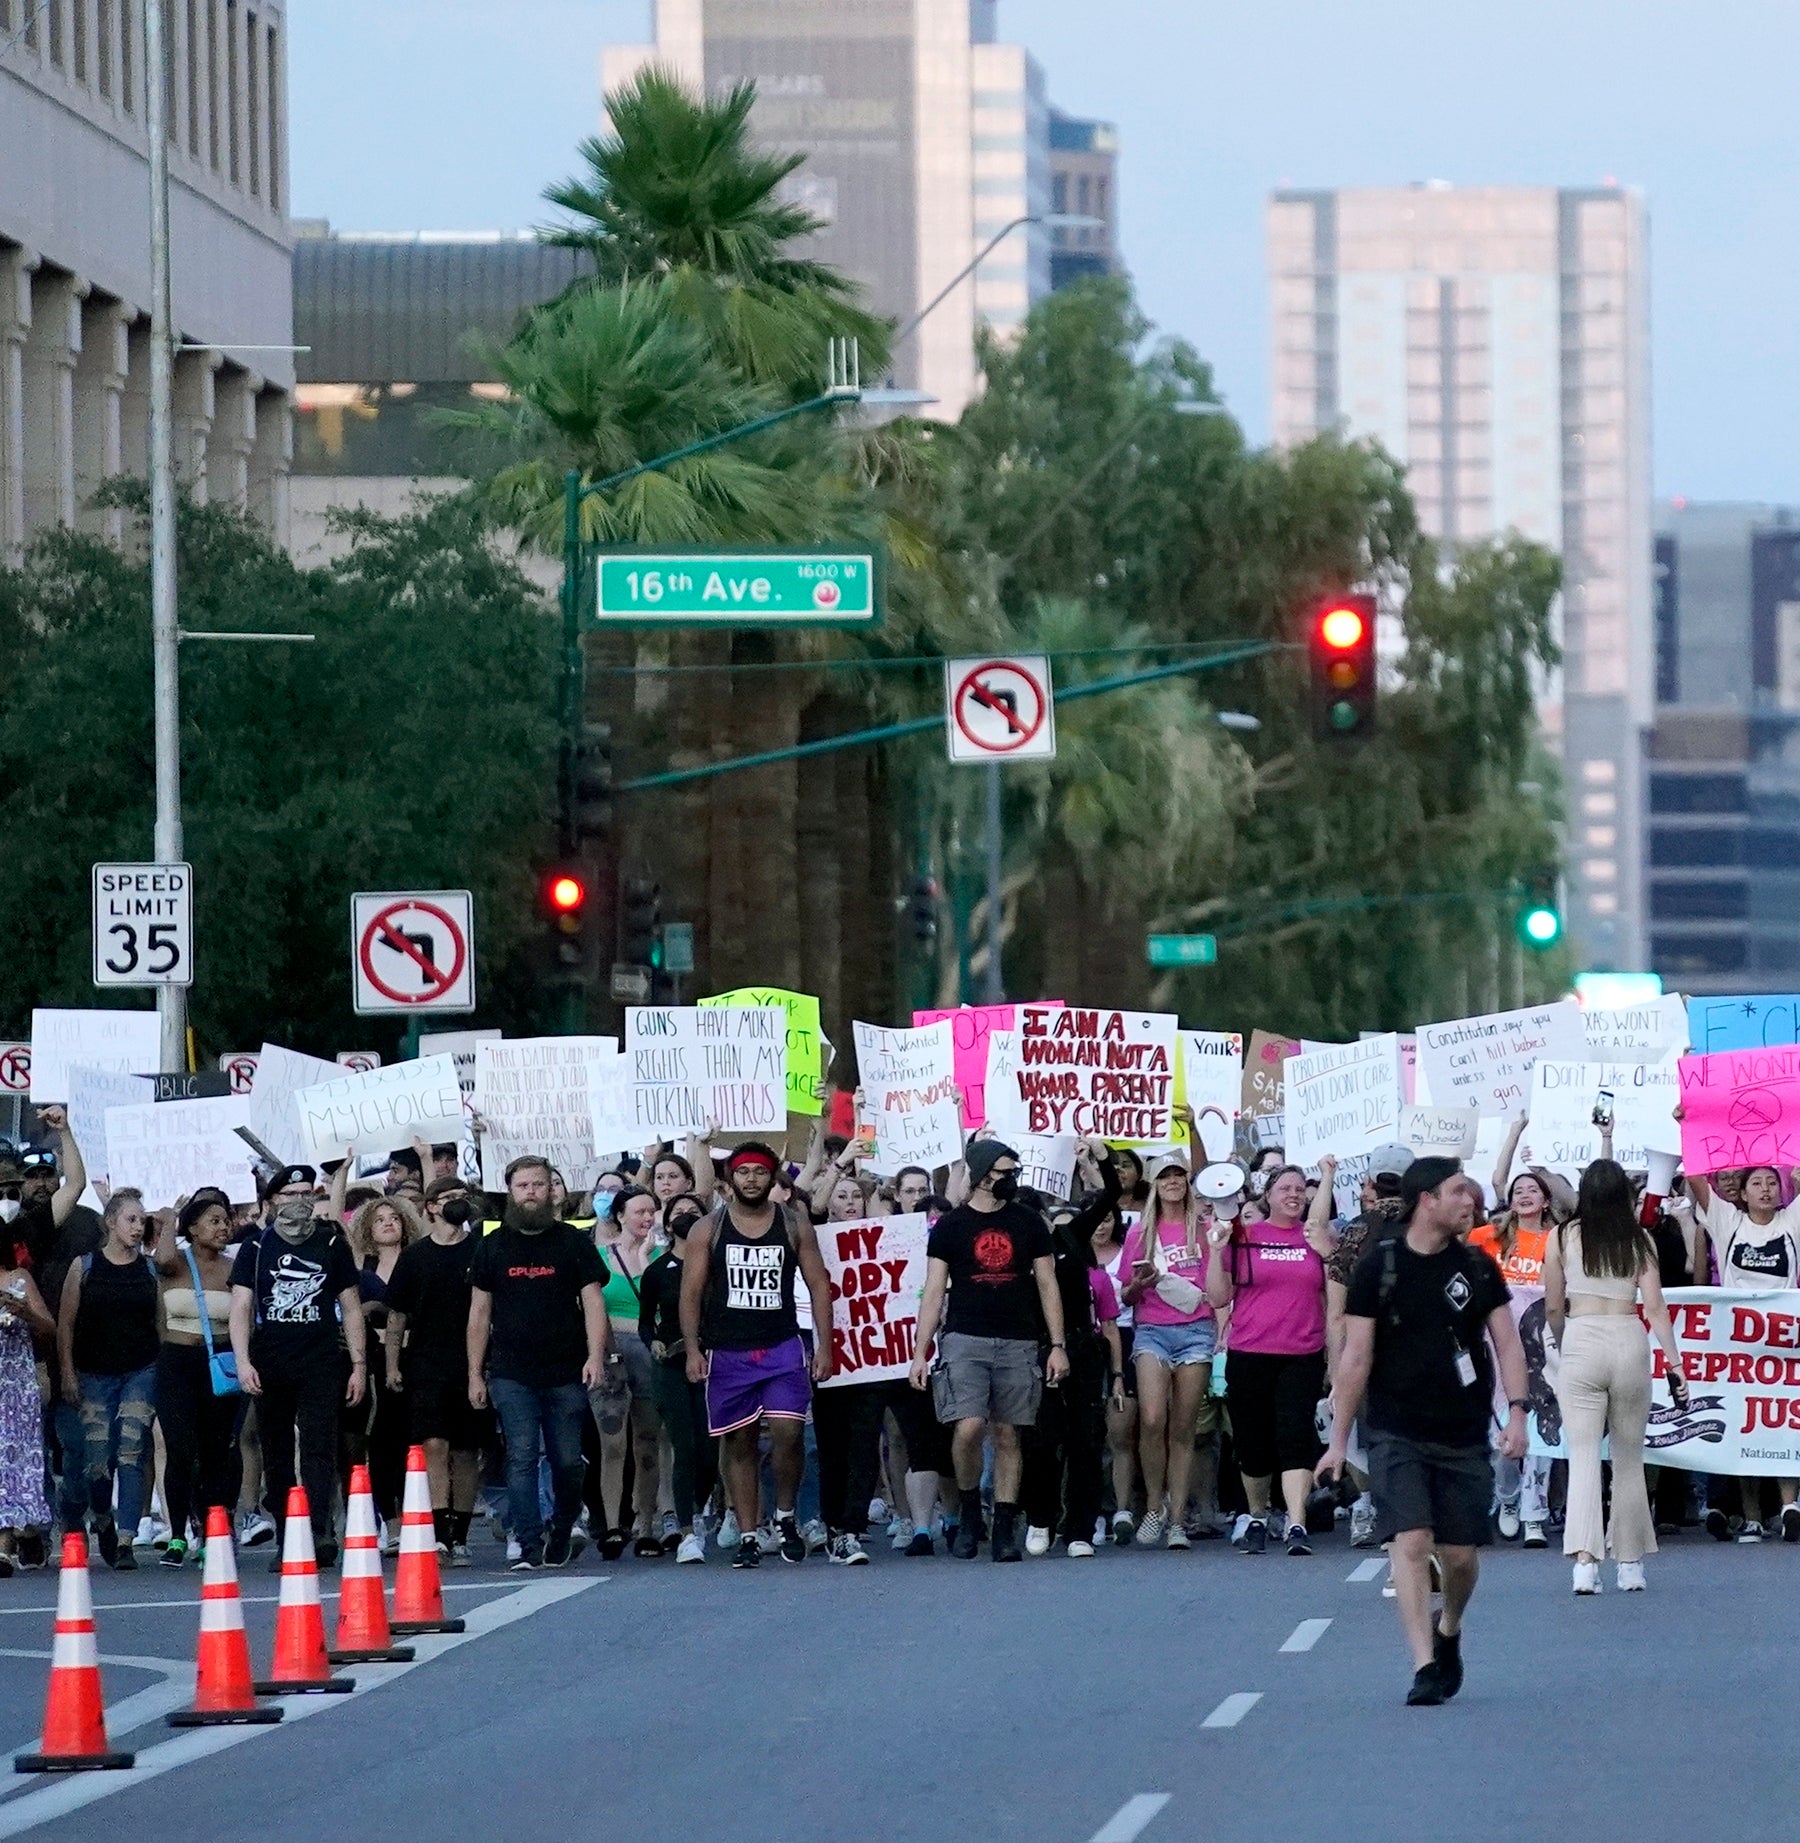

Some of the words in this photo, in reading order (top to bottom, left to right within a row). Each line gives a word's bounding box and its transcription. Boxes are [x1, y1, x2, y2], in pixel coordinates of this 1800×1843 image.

[797, 563, 838, 578] 1600
[844, 564, 857, 578] W
[626, 571, 693, 602] 16th
[702, 571, 782, 603] Ave.
[102, 873, 184, 893] SPEED
[110, 898, 179, 916] LIMIT
[105, 922, 181, 975] 35
[636, 1010, 678, 1037] GUNS
[696, 1010, 730, 1039] HAVE
[737, 1010, 777, 1041] MORE
[1022, 1008, 1050, 1038] I
[1053, 1009, 1100, 1040] AM
[1102, 1012, 1126, 1042] A
[1426, 1021, 1499, 1050] Constitution
[1502, 1020, 1524, 1035] says
[1531, 1011, 1553, 1030] you
[1613, 1009, 1662, 1033] WONT
[892, 1029, 940, 1053] Wanted
[1512, 1035, 1548, 1054] babies
[634, 1046, 689, 1081] RIGHTS
[702, 1043, 742, 1081] THAN
[753, 1044, 785, 1081] MY
[879, 1053, 910, 1071] The
[1021, 1038, 1101, 1067] WOMAN
[1105, 1040, 1154, 1070] NOT
[1147, 1044, 1169, 1072] A
[1291, 1061, 1315, 1083] PRO
[1315, 1052, 1336, 1076] LIFE
[1338, 1049, 1350, 1066] IS
[1353, 1045, 1361, 1061] A
[1364, 1040, 1385, 1058] LIE
[301, 1078, 351, 1104] MY
[359, 1059, 442, 1091] BODY
[1451, 1071, 1487, 1087] unless
[1542, 1063, 1587, 1089] Don't
[1598, 1063, 1626, 1088] Like
[1677, 1054, 1717, 1090] WE
[1729, 1050, 1799, 1088] WONT
[884, 1089, 912, 1113] MY
[1016, 1070, 1085, 1102] WOMB.
[1090, 1071, 1173, 1106] PARENT
[1296, 1084, 1325, 1118] YOU
[1329, 1069, 1363, 1104] DONT
[1362, 1062, 1393, 1092] CARE
[1468, 1094, 1480, 1108] a
[1491, 1083, 1523, 1111] gun
[307, 1103, 360, 1151] MY
[360, 1086, 461, 1136] CHOICE
[635, 1083, 705, 1128] FUCKING
[712, 1082, 776, 1128] UTERUS
[1028, 1098, 1069, 1133] BY
[1072, 1100, 1170, 1139] CHOICE
[902, 1114, 941, 1141] Fuck
[1296, 1123, 1311, 1148] IF
[1362, 1093, 1392, 1130] DIE
[1410, 1111, 1433, 1138] My
[1437, 1116, 1467, 1137] body
[887, 1139, 945, 1166] Senator
[1544, 1140, 1593, 1164] School
[727, 1246, 782, 1267] BLACK
[835, 1225, 884, 1262] MY
[1281, 1247, 1308, 1256] OUR
[1259, 1254, 1306, 1263] BODIES
[1741, 1260, 1778, 1268] BODIES
[729, 1268, 779, 1291] LIVES
[728, 1292, 782, 1309] MATTER
[848, 1293, 888, 1327] MY
[1740, 1447, 1791, 1461] National
